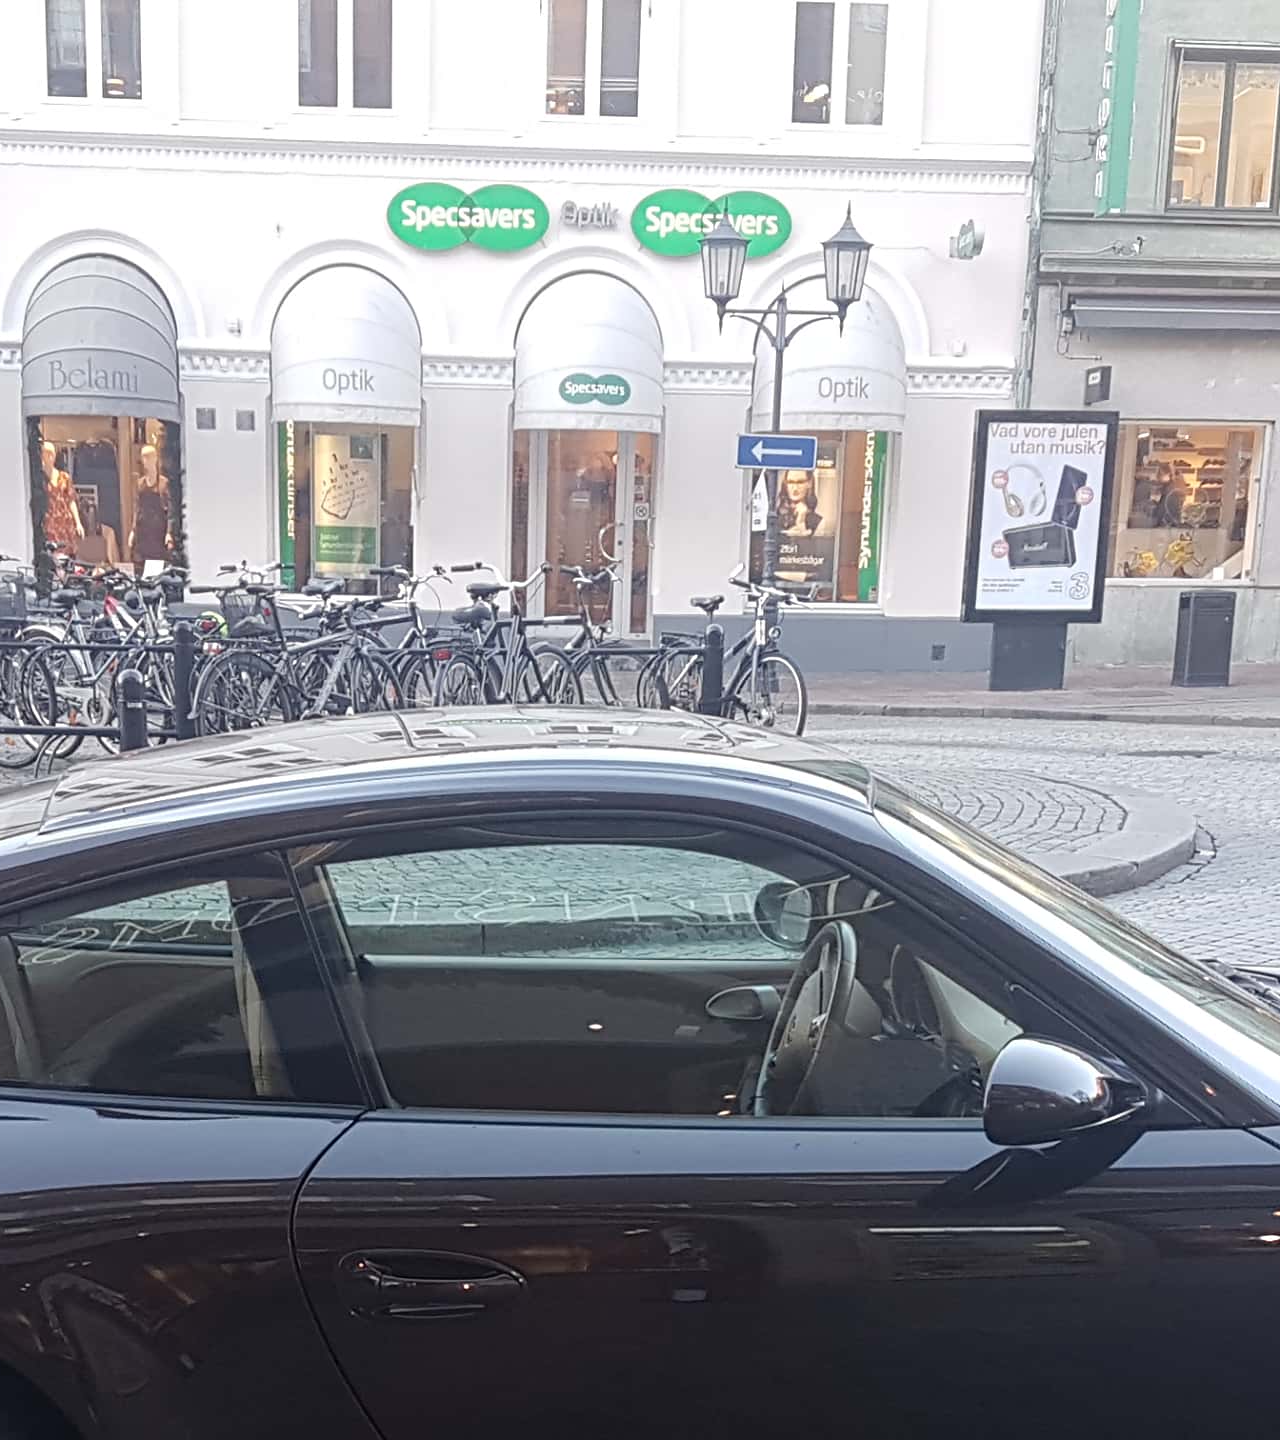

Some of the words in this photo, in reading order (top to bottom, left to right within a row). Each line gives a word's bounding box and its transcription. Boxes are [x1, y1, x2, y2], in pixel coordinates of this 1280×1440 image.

[400, 199, 536, 233] Specsavers
[560, 200, 620, 231] Optik
[644, 205, 780, 236] Specsavers
[48, 356, 139, 393] Belami
[322, 368, 375, 396] Optik
[564, 381, 625, 398] Specsavers
[818, 376, 870, 402] Optik
[989, 424, 1018, 438] Vad
[1023, 426, 1057, 438] vore
[1060, 425, 1098, 442] julen
[1010, 441, 1046, 455] utan
[1049, 440, 1107, 456] musik?
